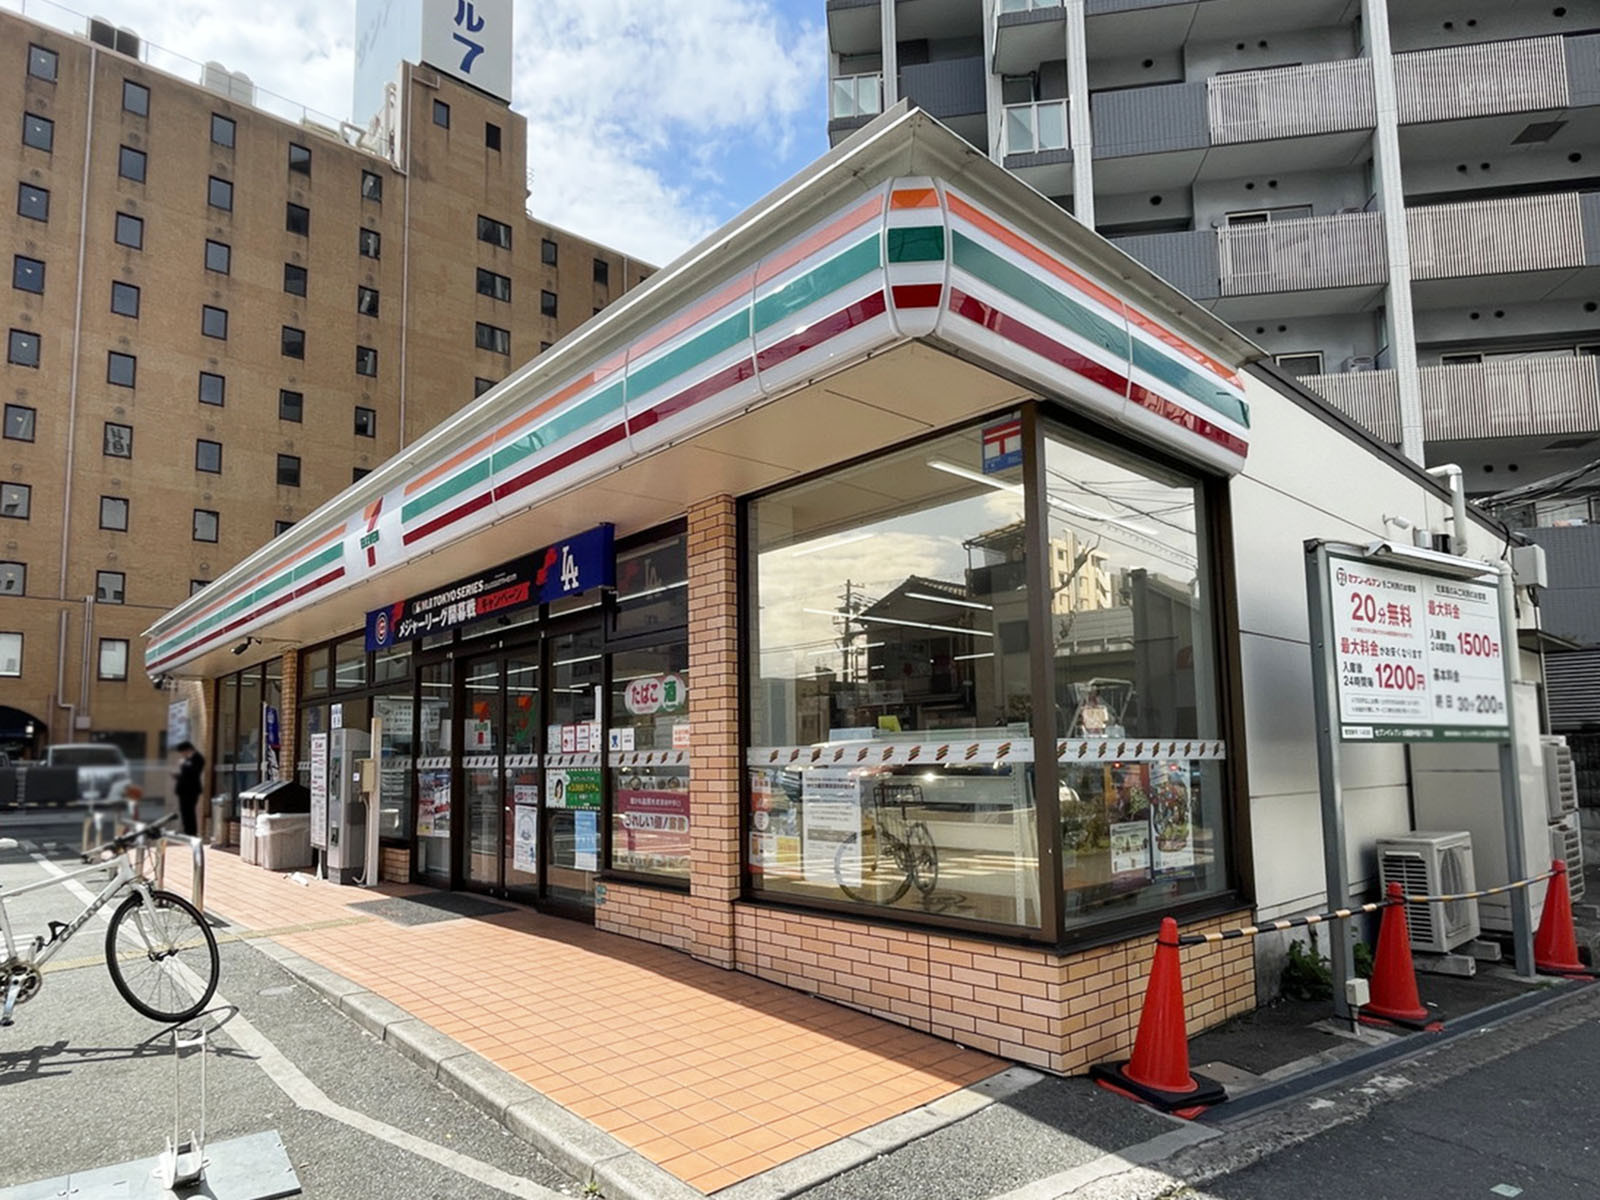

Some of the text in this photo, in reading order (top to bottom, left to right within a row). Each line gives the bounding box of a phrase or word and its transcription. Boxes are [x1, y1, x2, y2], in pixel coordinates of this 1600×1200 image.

[560, 545, 579, 591] LA
[434, 589, 456, 607] TOKYO
[457, 580, 484, 599] SERIES
[398, 598, 477, 638] メジャーリーグ開幕戦
[1351, 592, 1412, 628] 20分無料
[1428, 600, 1460, 619] 最大料金
[1457, 632, 1500, 658] 1500円
[1375, 663, 1426, 691] 1200円
[632, 683, 658, 704] たばこ
[664, 680, 677, 703] 酒
